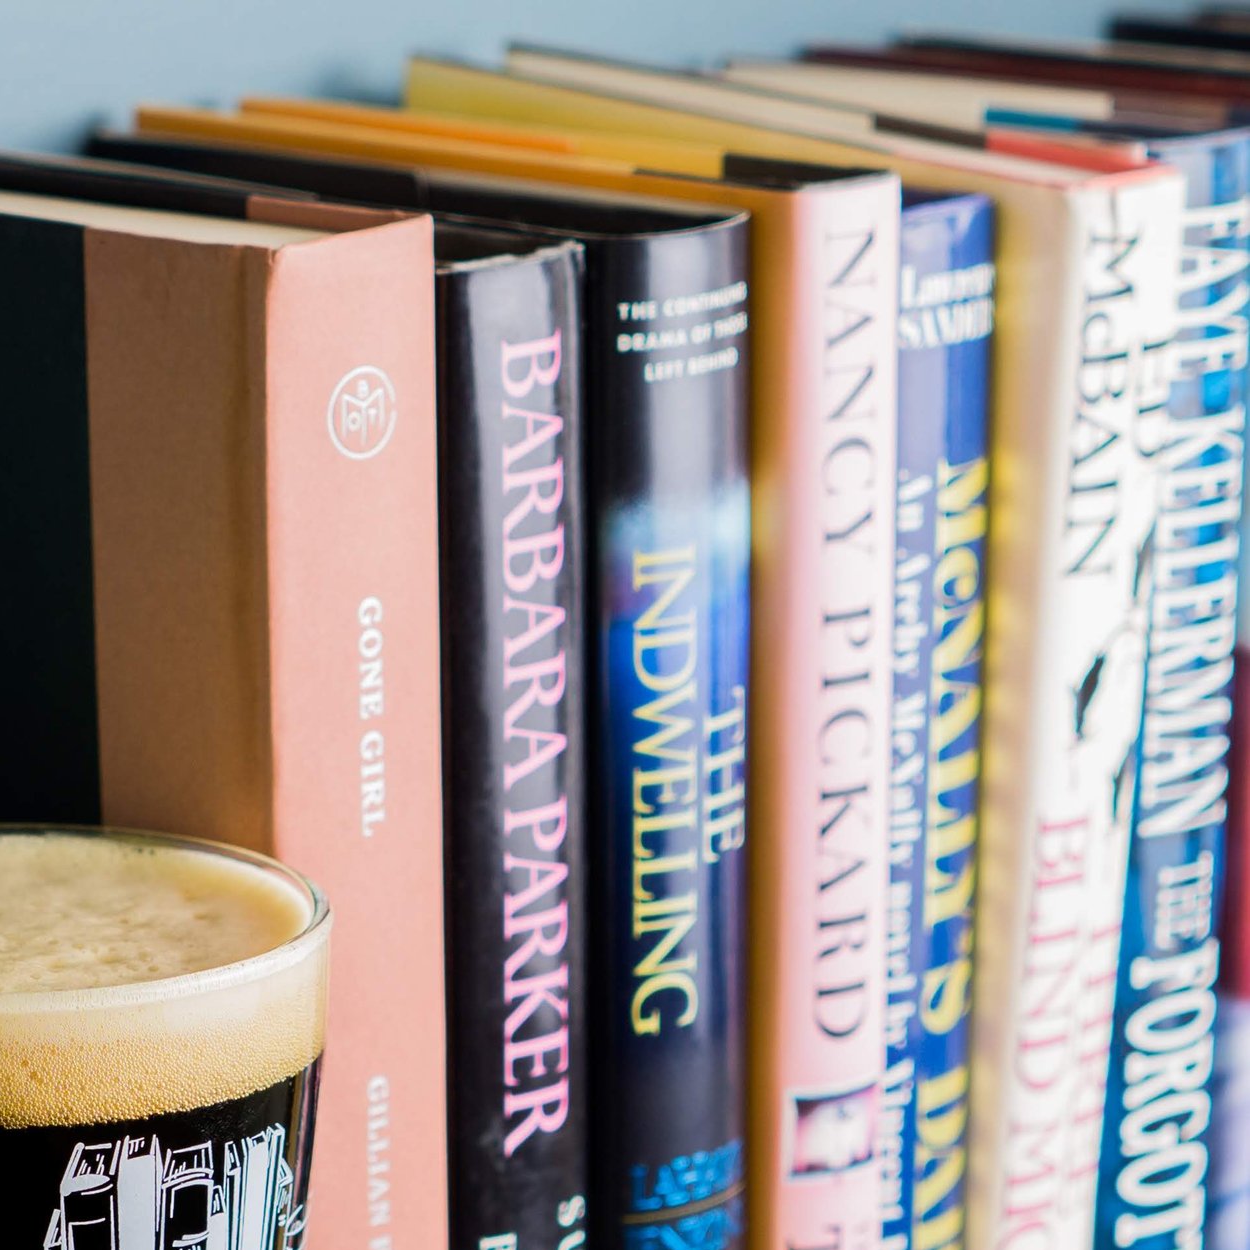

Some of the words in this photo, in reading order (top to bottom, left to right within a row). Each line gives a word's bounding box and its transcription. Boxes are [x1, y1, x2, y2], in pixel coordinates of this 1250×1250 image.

[617, 301, 656, 321] THE
[617, 328, 687, 353] DRAMA
[644, 359, 684, 383] LEFT
[1176, 198, 1250, 381] FAYE
[820, 225, 877, 566] NANCY
[1064, 232, 1140, 575] McBAIN
[501, 328, 568, 791] BARBARA
[1137, 404, 1246, 838] KELLERMAN
[357, 596, 384, 722] GONE
[920, 456, 989, 1035] McNALLY'S
[360, 731, 386, 838] GIRL
[632, 545, 698, 1036] INDWELLING
[704, 684, 745, 863] THE
[812, 605, 871, 1042] PICKARD
[503, 794, 570, 1156] PARKER
[1156, 852, 1213, 950] THE
[366, 1074, 391, 1227] GILLIAN
